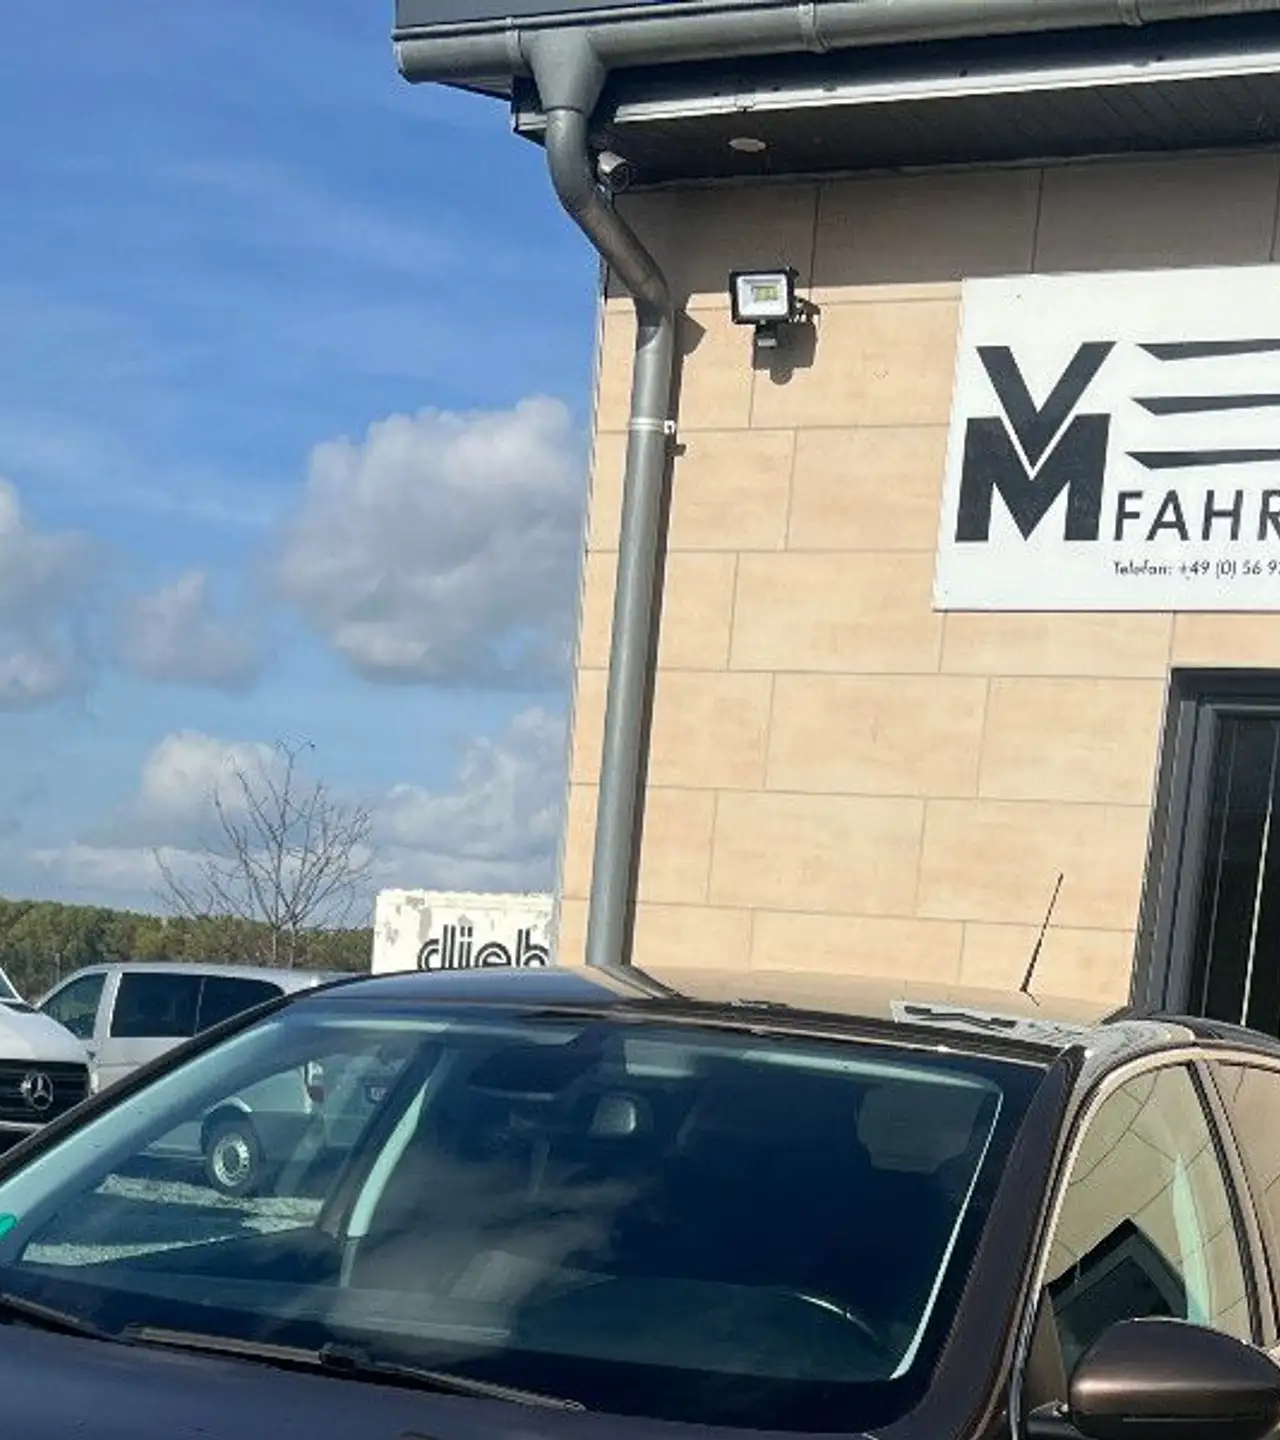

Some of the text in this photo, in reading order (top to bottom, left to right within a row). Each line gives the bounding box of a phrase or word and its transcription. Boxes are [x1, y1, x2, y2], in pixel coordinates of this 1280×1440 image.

[1114, 559, 1172, 576] Telefon:
[1180, 559, 1210, 576] +49
[1216, 559, 1238, 580] (0)
[1242, 559, 1263, 576] 56
